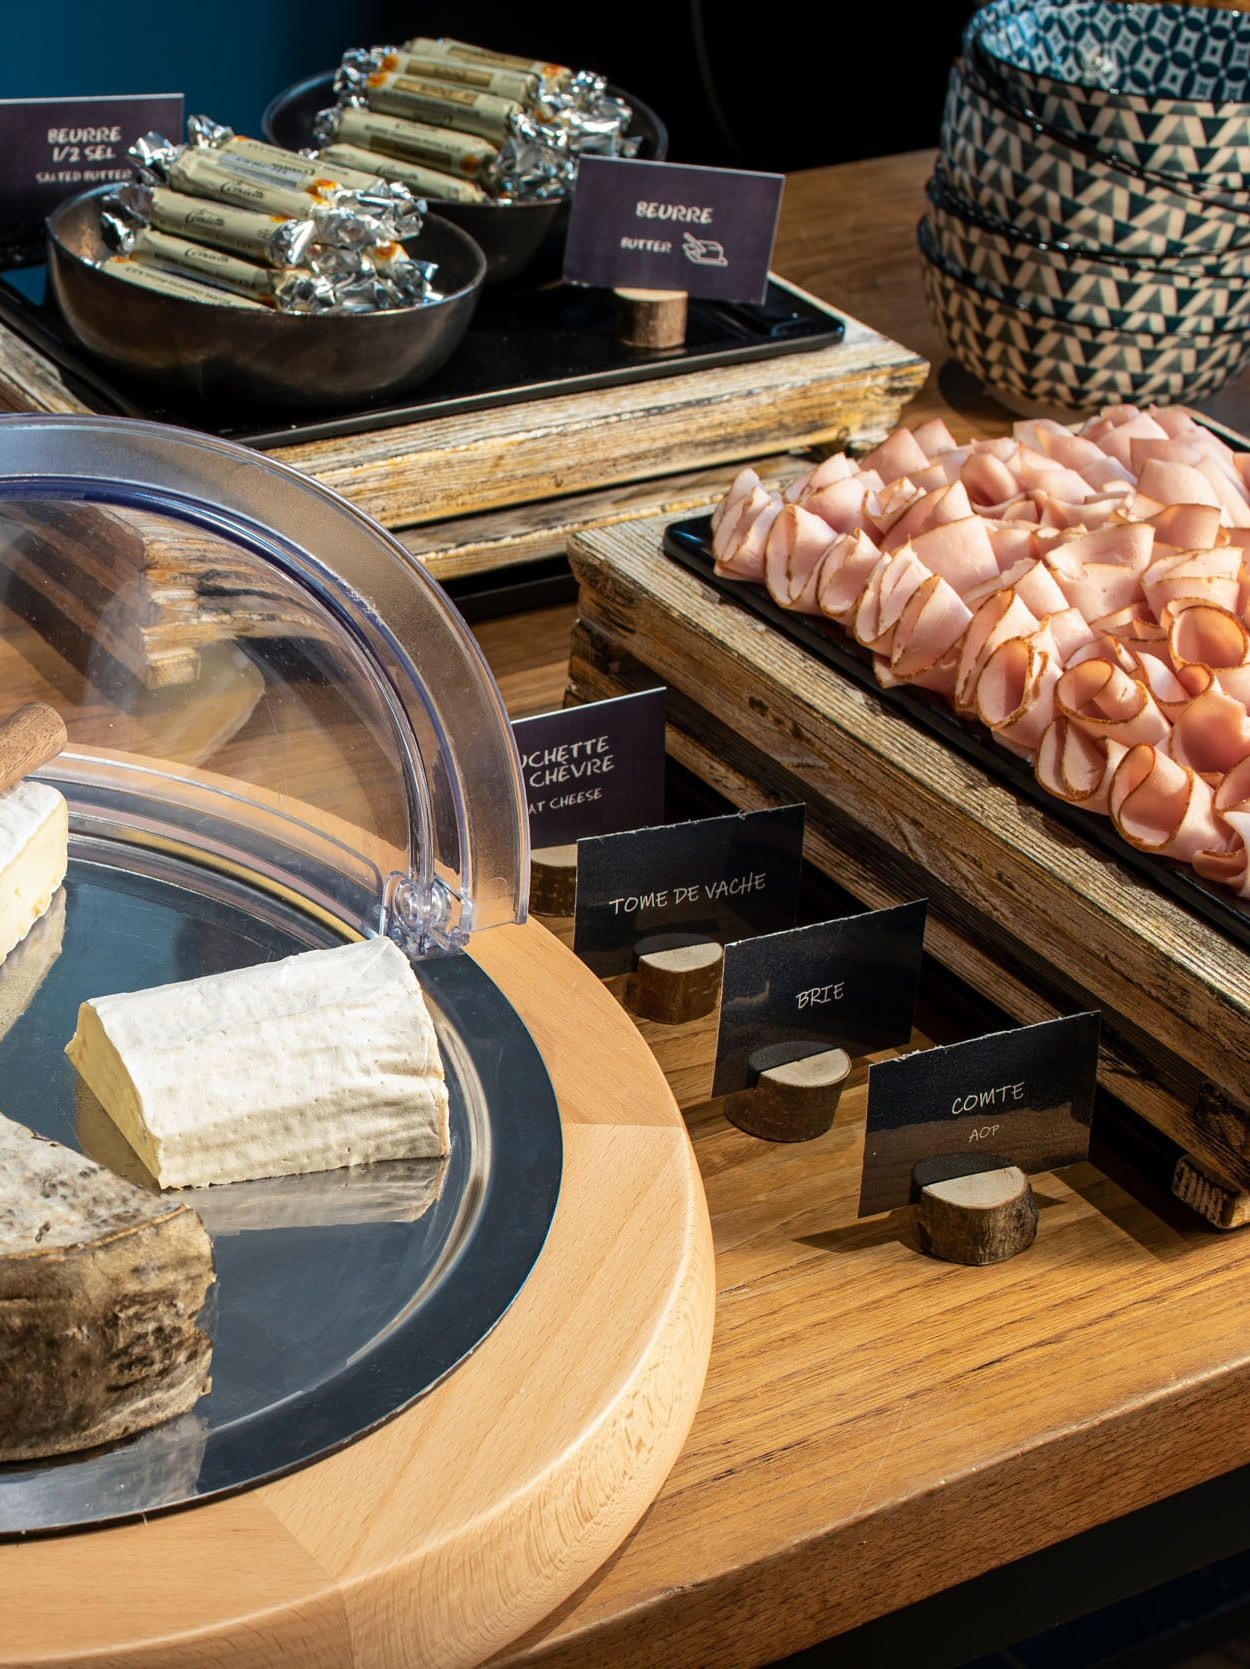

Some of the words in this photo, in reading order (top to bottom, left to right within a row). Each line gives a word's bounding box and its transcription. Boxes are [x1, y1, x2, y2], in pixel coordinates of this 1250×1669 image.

[47, 127, 123, 144] BEURRE
[52, 146, 81, 163] 1/2
[83, 145, 116, 160] SEL
[35, 171, 81, 184] SALTED
[636, 202, 713, 224] BEURRE
[620, 237, 672, 253] BUTTER
[549, 787, 603, 809] CHEESE
[608, 890, 668, 915] TOME
[673, 885, 700, 905] DE
[705, 872, 767, 900] VACHE
[795, 981, 846, 1010] BRIE
[951, 1081, 1026, 1115] COMTE
[967, 1123, 1001, 1144] AOP
